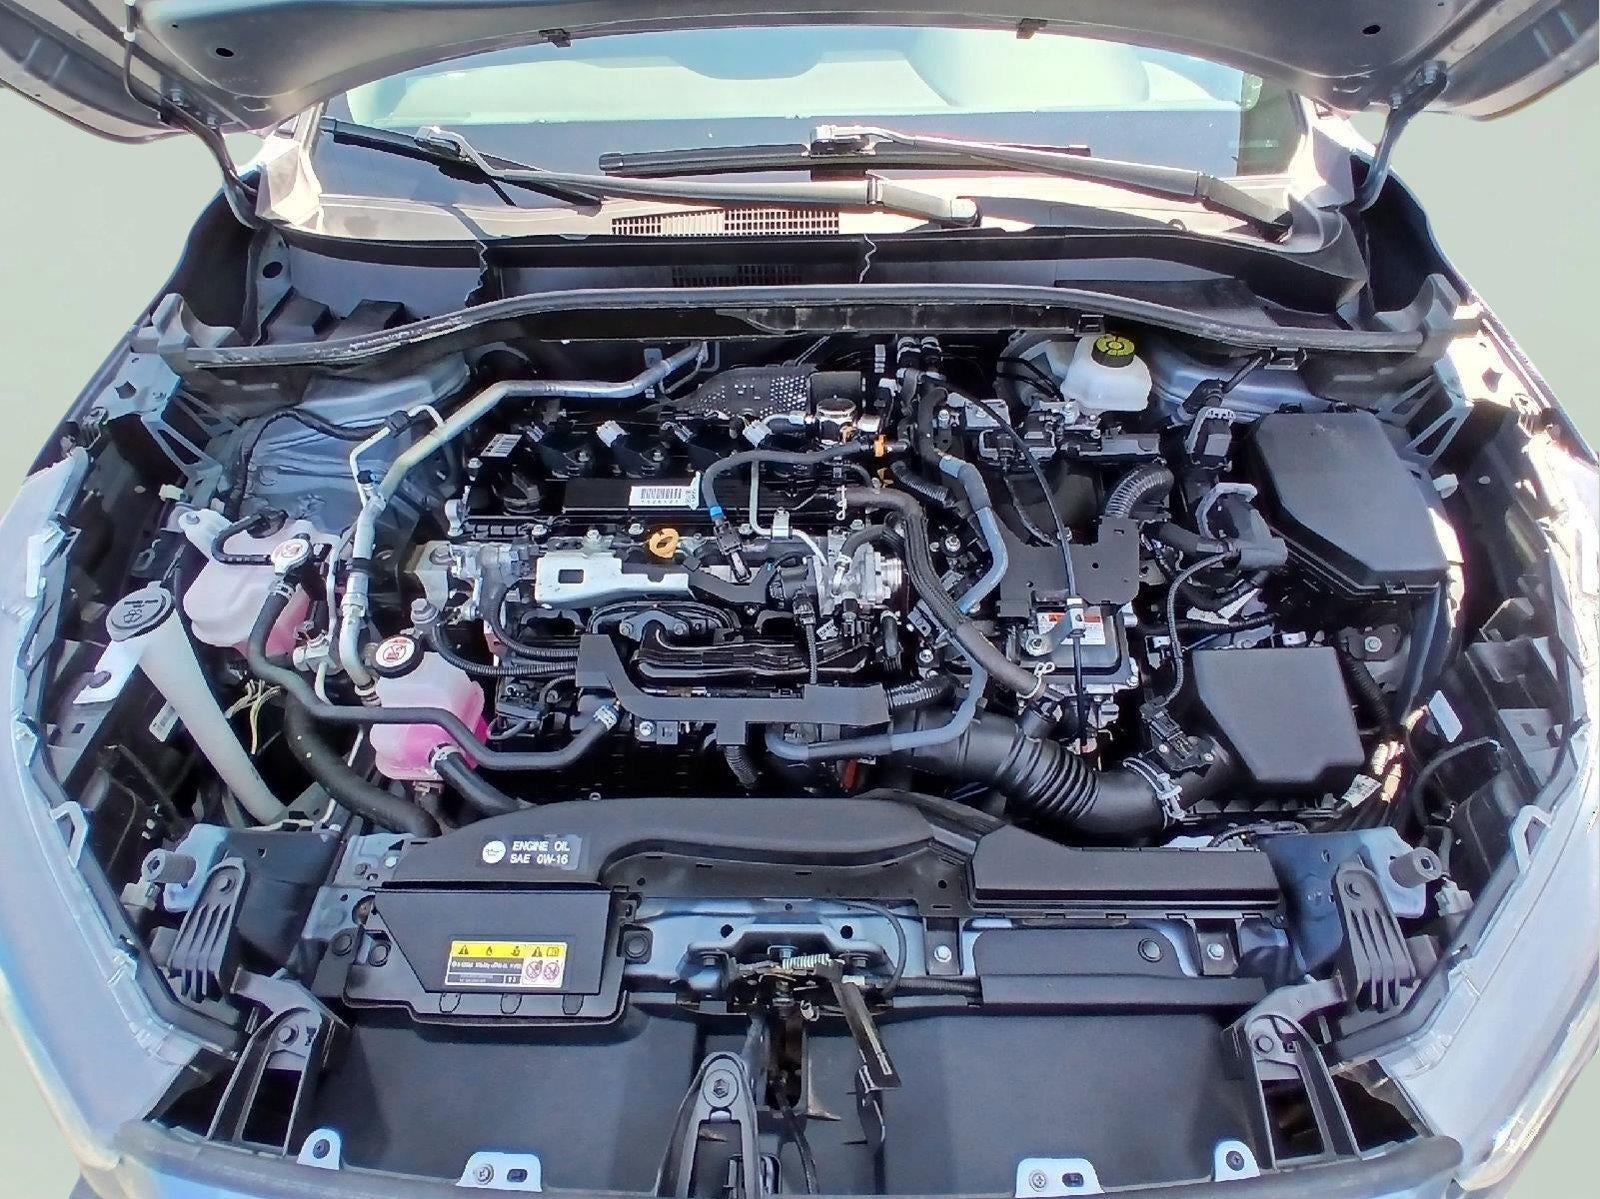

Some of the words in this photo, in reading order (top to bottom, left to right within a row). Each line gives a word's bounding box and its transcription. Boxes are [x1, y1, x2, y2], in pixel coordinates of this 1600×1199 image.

[512, 840, 549, 852] ENGINE
[554, 840, 571, 852] OIL
[510, 853, 531, 864] SAE
[536, 853, 569, 865] 0W-16
